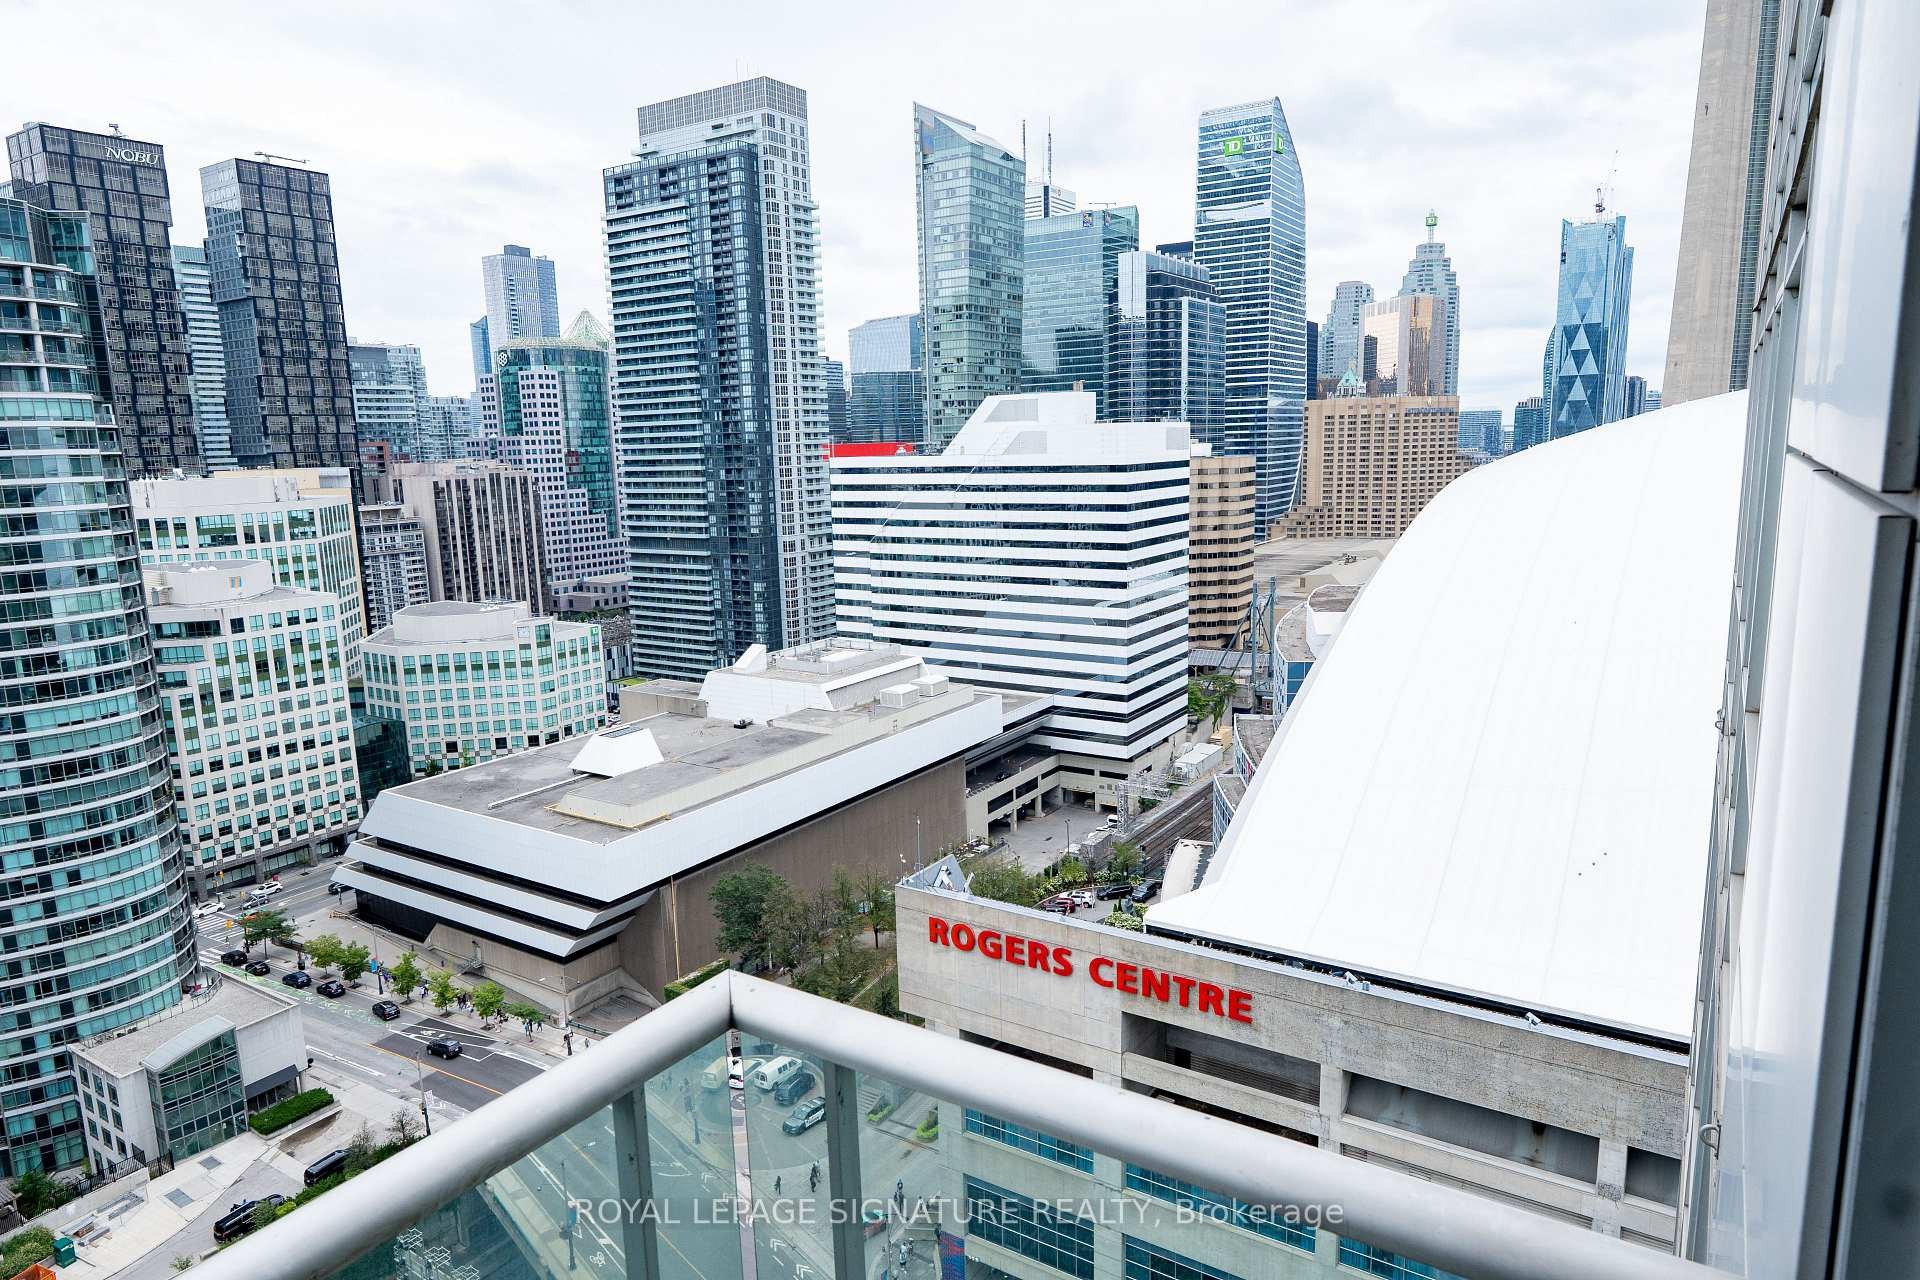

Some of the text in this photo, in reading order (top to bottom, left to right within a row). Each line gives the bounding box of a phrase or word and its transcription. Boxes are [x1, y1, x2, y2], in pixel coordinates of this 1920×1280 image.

[104, 146, 159, 165] NOBU
[1224, 140, 1241, 152] TD
[928, 916, 1253, 1024] ROGERS CENTRE
